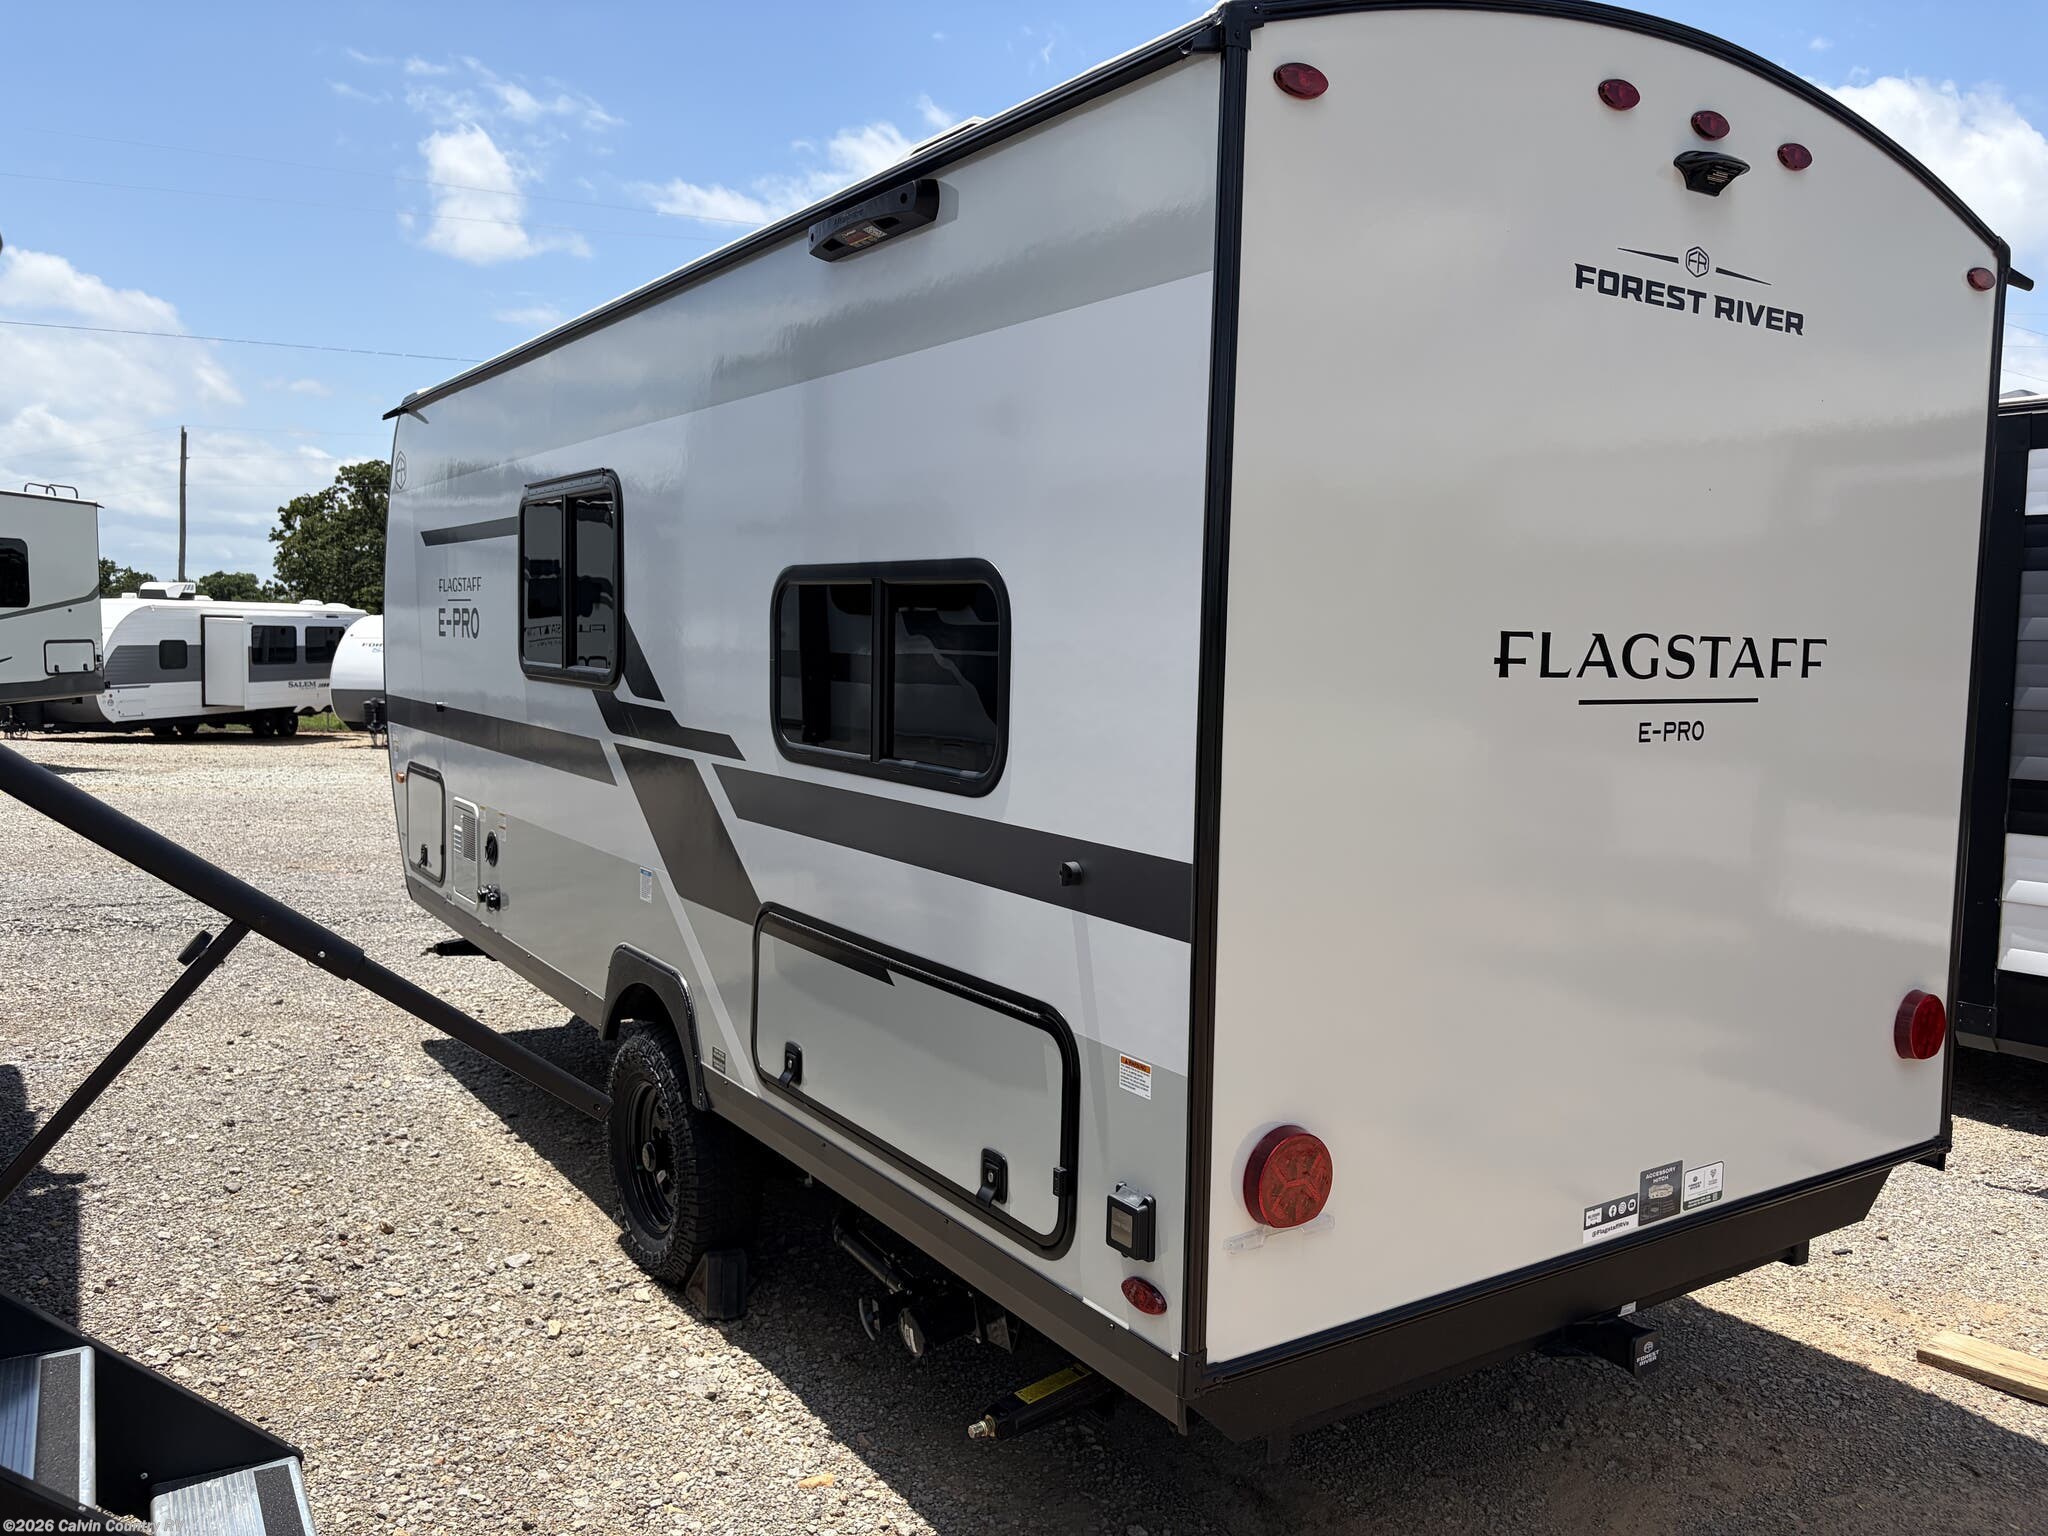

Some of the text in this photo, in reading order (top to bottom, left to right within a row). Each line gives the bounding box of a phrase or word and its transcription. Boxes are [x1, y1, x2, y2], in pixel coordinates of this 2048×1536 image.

[1574, 263, 1804, 336] FOREST RIVER
[438, 576, 482, 593] FLAGSTAFF
[438, 607, 480, 639] E-PRO
[1493, 630, 1828, 680] FLAGSTAFF
[288, 680, 317, 689] SALEM
[1638, 720, 1705, 743] E-PRO
[1645, 1166, 1677, 1180] ACCESSORY
[1652, 1174, 1669, 1184] HITCH
